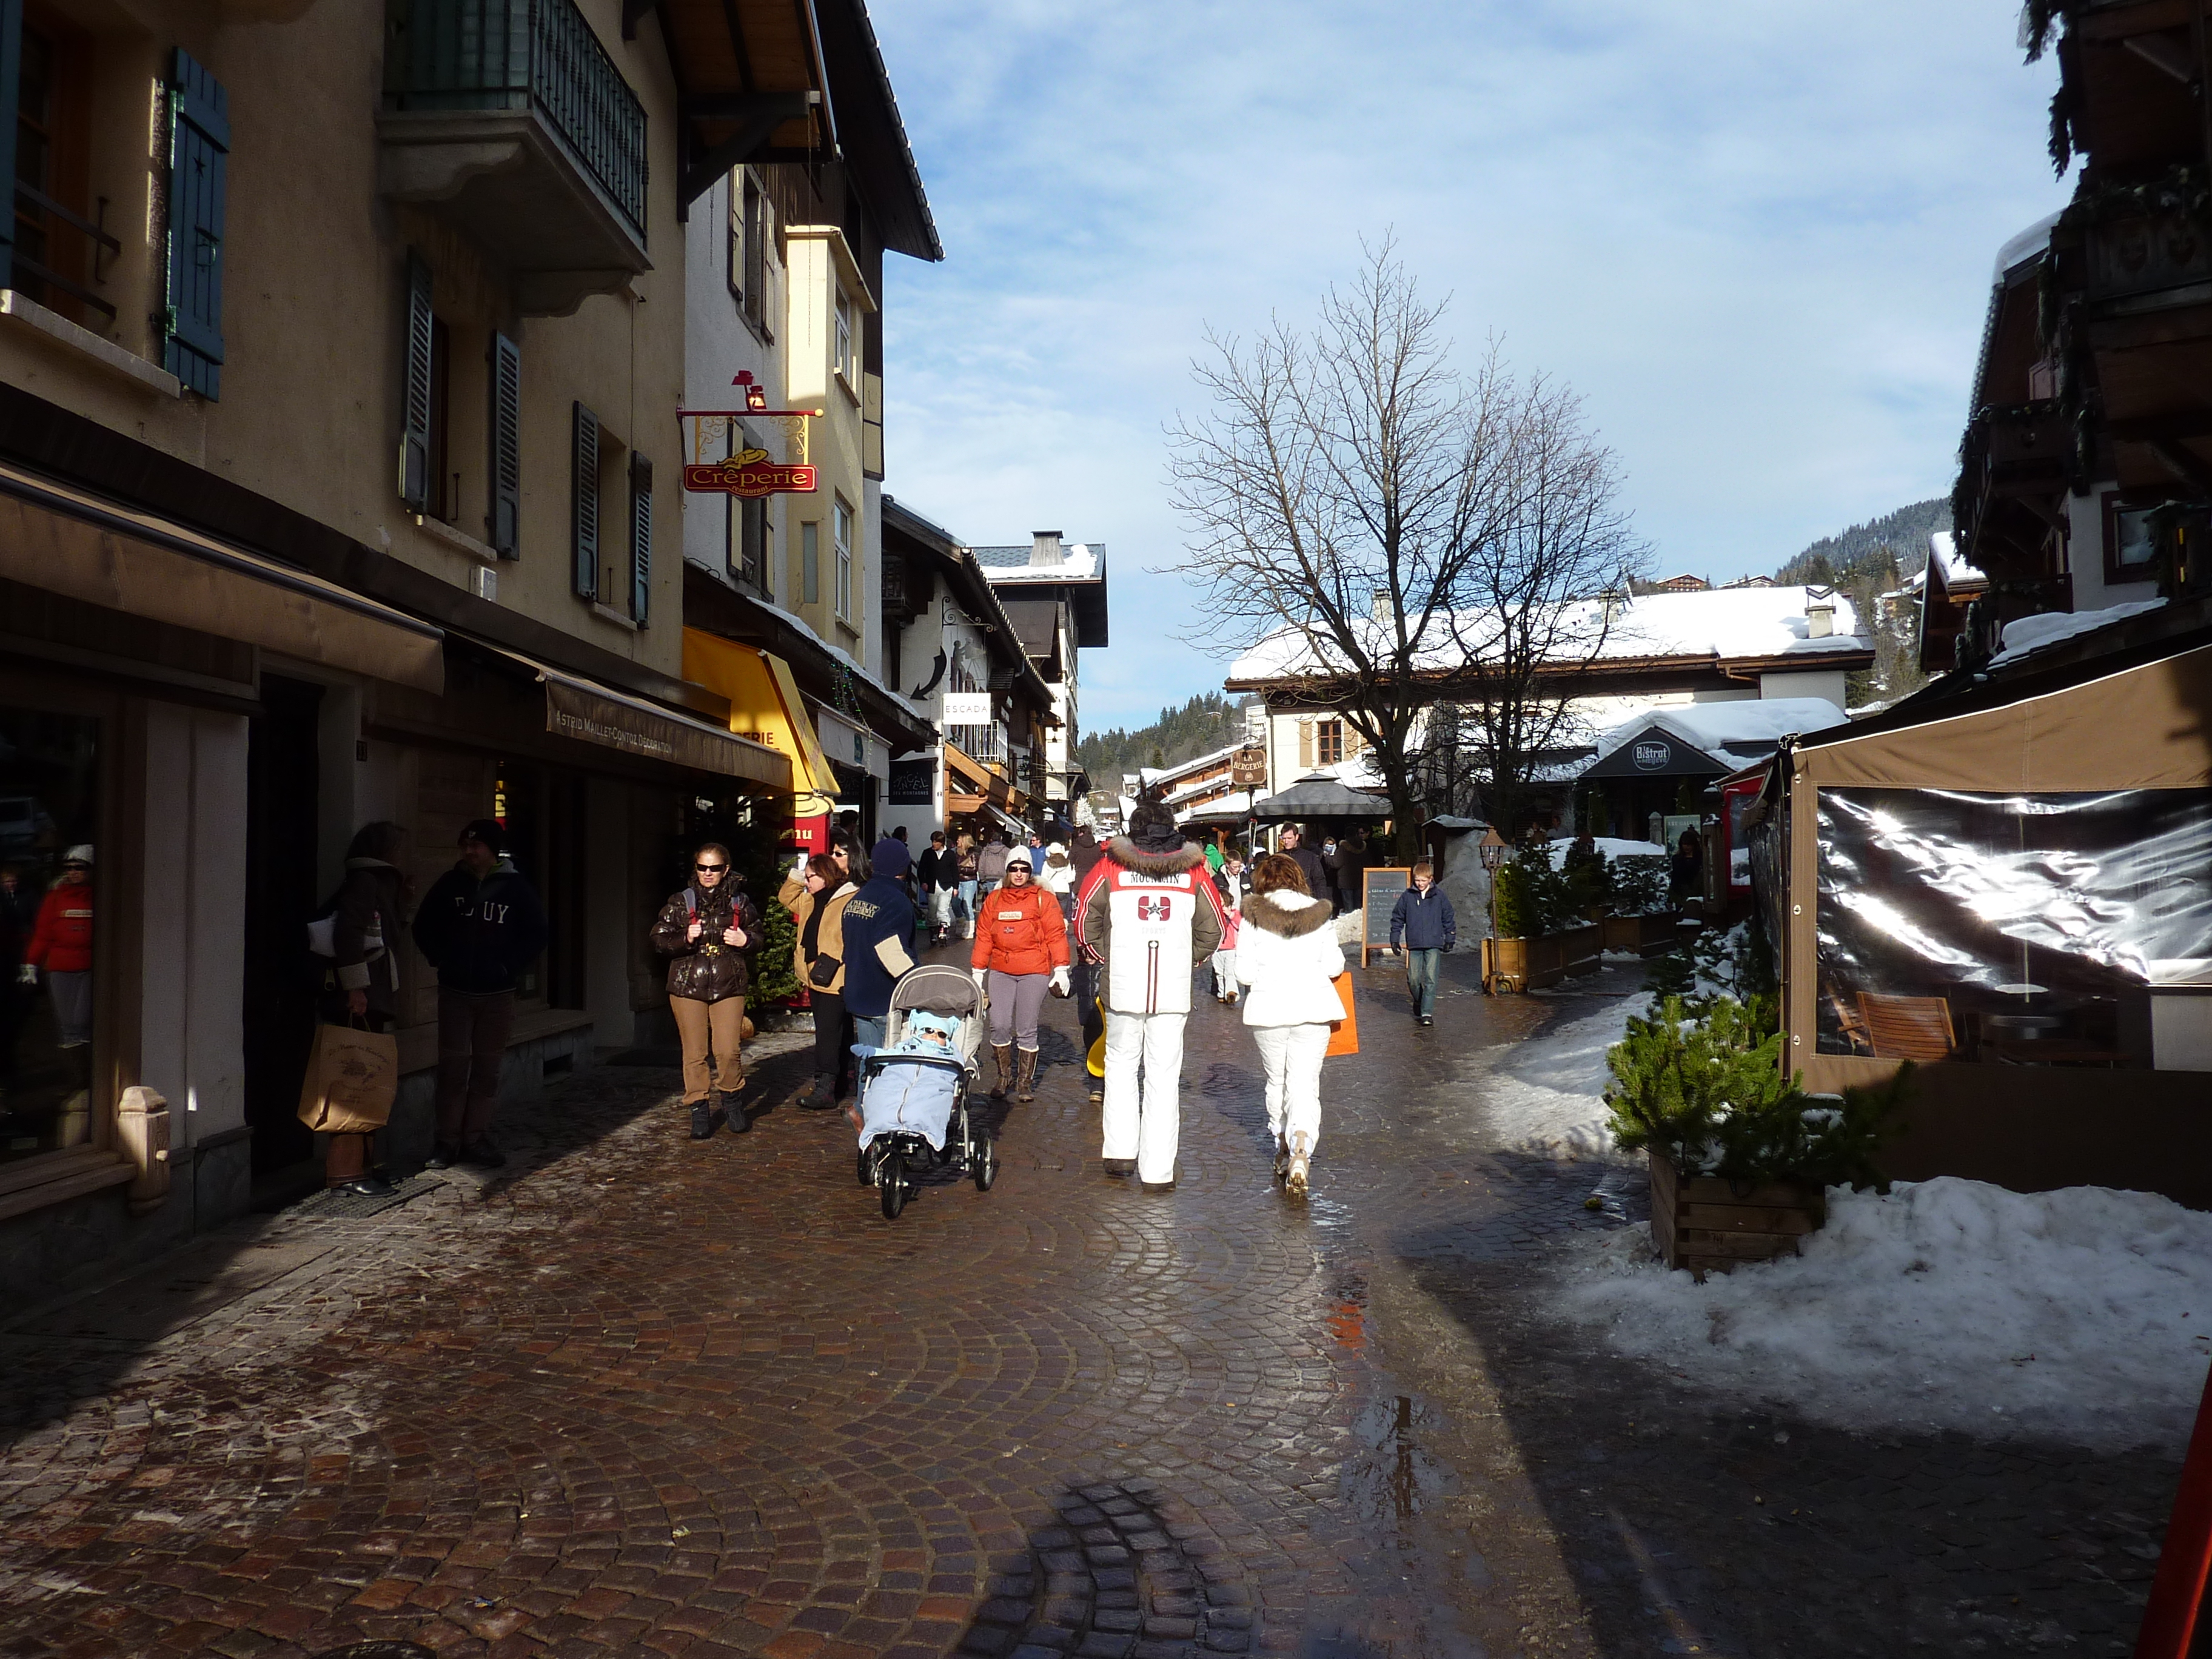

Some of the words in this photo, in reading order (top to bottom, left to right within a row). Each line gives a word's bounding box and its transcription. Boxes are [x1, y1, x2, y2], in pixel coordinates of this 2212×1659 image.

[692, 469, 808, 487] Crêperie
[731, 484, 769, 494] restaurant
[1637, 746, 1667, 759] Bistrot
[1233, 760, 1264, 770] BERGERIE
[1131, 874, 1180, 884] MOUNAIN
